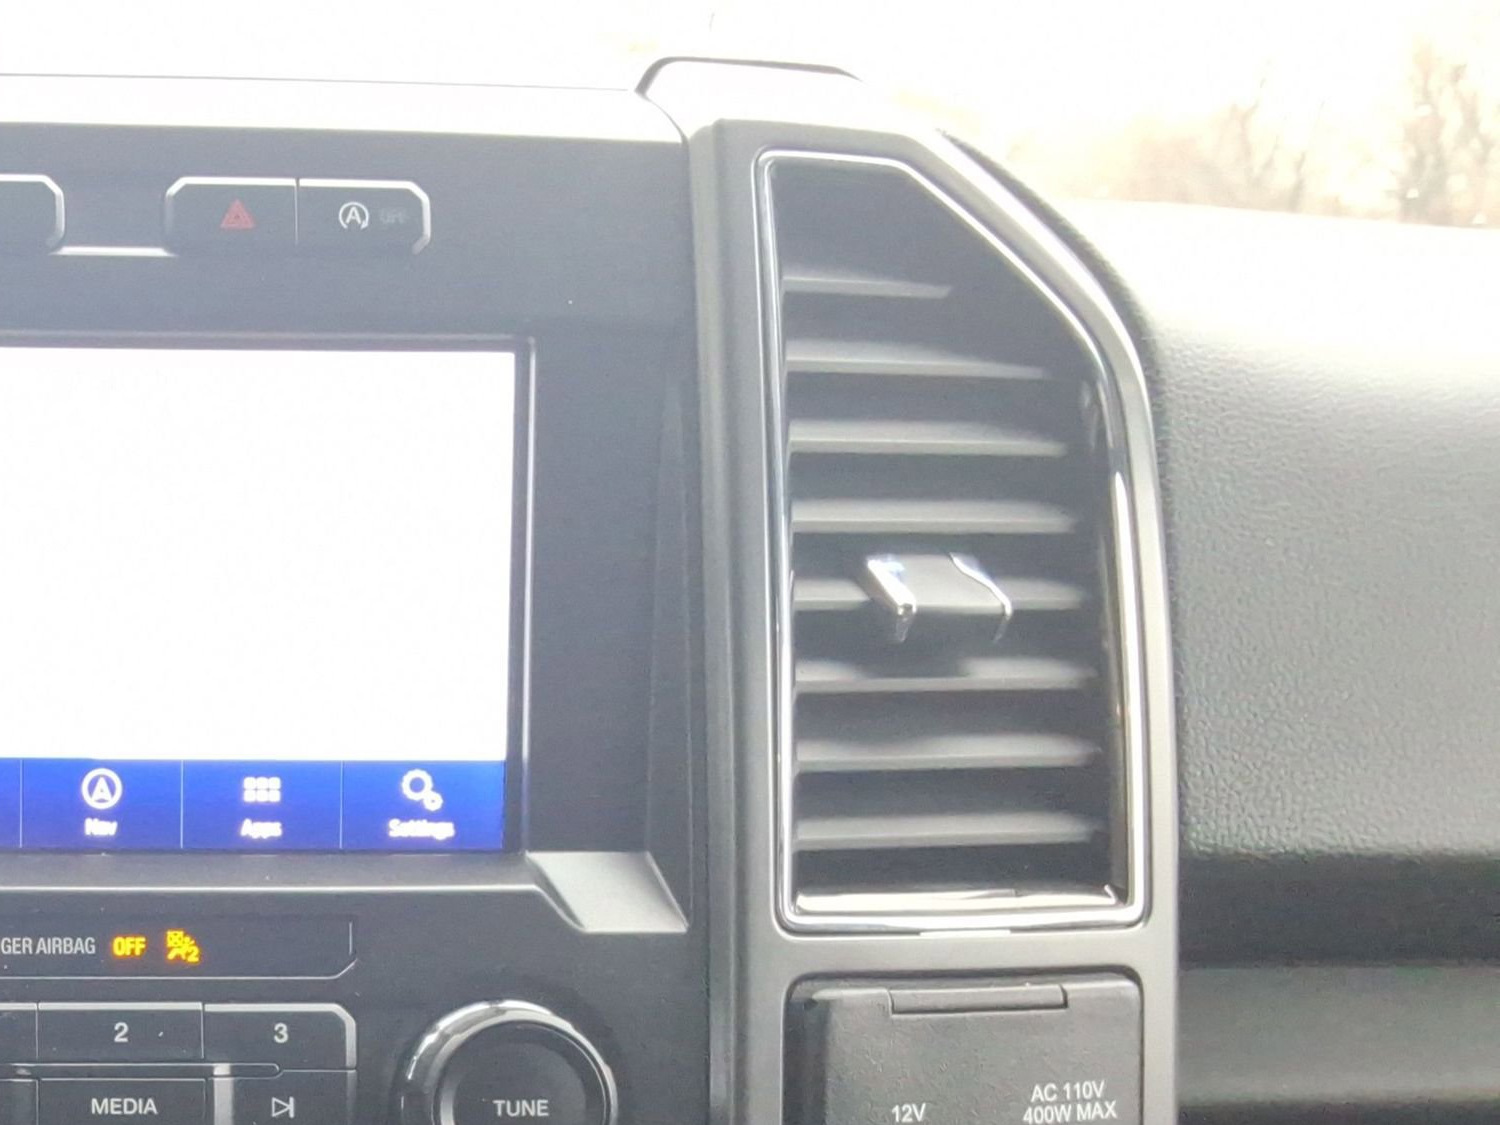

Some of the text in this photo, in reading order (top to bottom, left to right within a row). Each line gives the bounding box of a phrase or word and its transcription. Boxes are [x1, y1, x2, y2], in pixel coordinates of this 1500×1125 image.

[240, 818, 282, 839] Apps
[388, 818, 455, 841] Settings
[37, 937, 96, 955] AIRBAG
[112, 936, 146, 956] OFF
[113, 1022, 129, 1042] 2
[273, 1023, 289, 1043] 3
[1031, 1080, 1106, 1102] AC 110V
[91, 1098, 158, 1115] MEDIA
[492, 1099, 550, 1117] TUNE
[891, 1103, 927, 1123] 12V
[1023, 1100, 1118, 1125] 400W MAX
